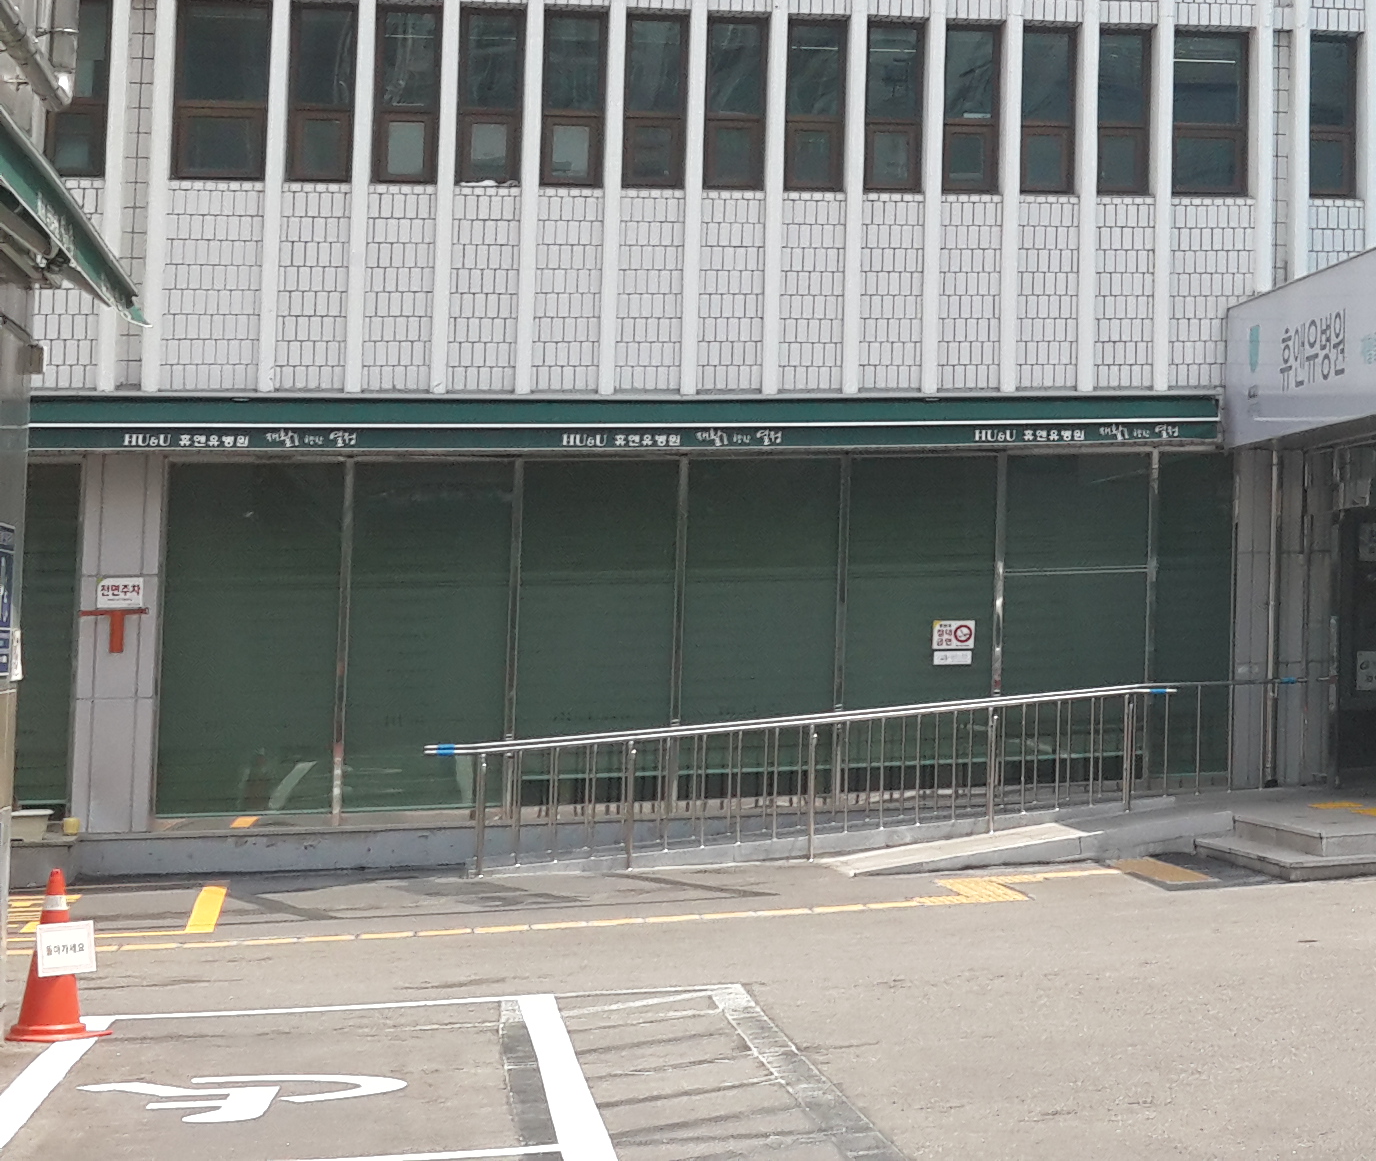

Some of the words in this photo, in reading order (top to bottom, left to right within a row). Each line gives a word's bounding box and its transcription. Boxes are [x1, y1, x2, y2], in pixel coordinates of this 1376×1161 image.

[1279, 308, 1347, 392] 휴앤유병원
[123, 433, 171, 447] HU&U
[562, 434, 607, 447] HU&U
[974, 430, 1017, 442] HU&U
[100, 584, 141, 597] 전면주차
